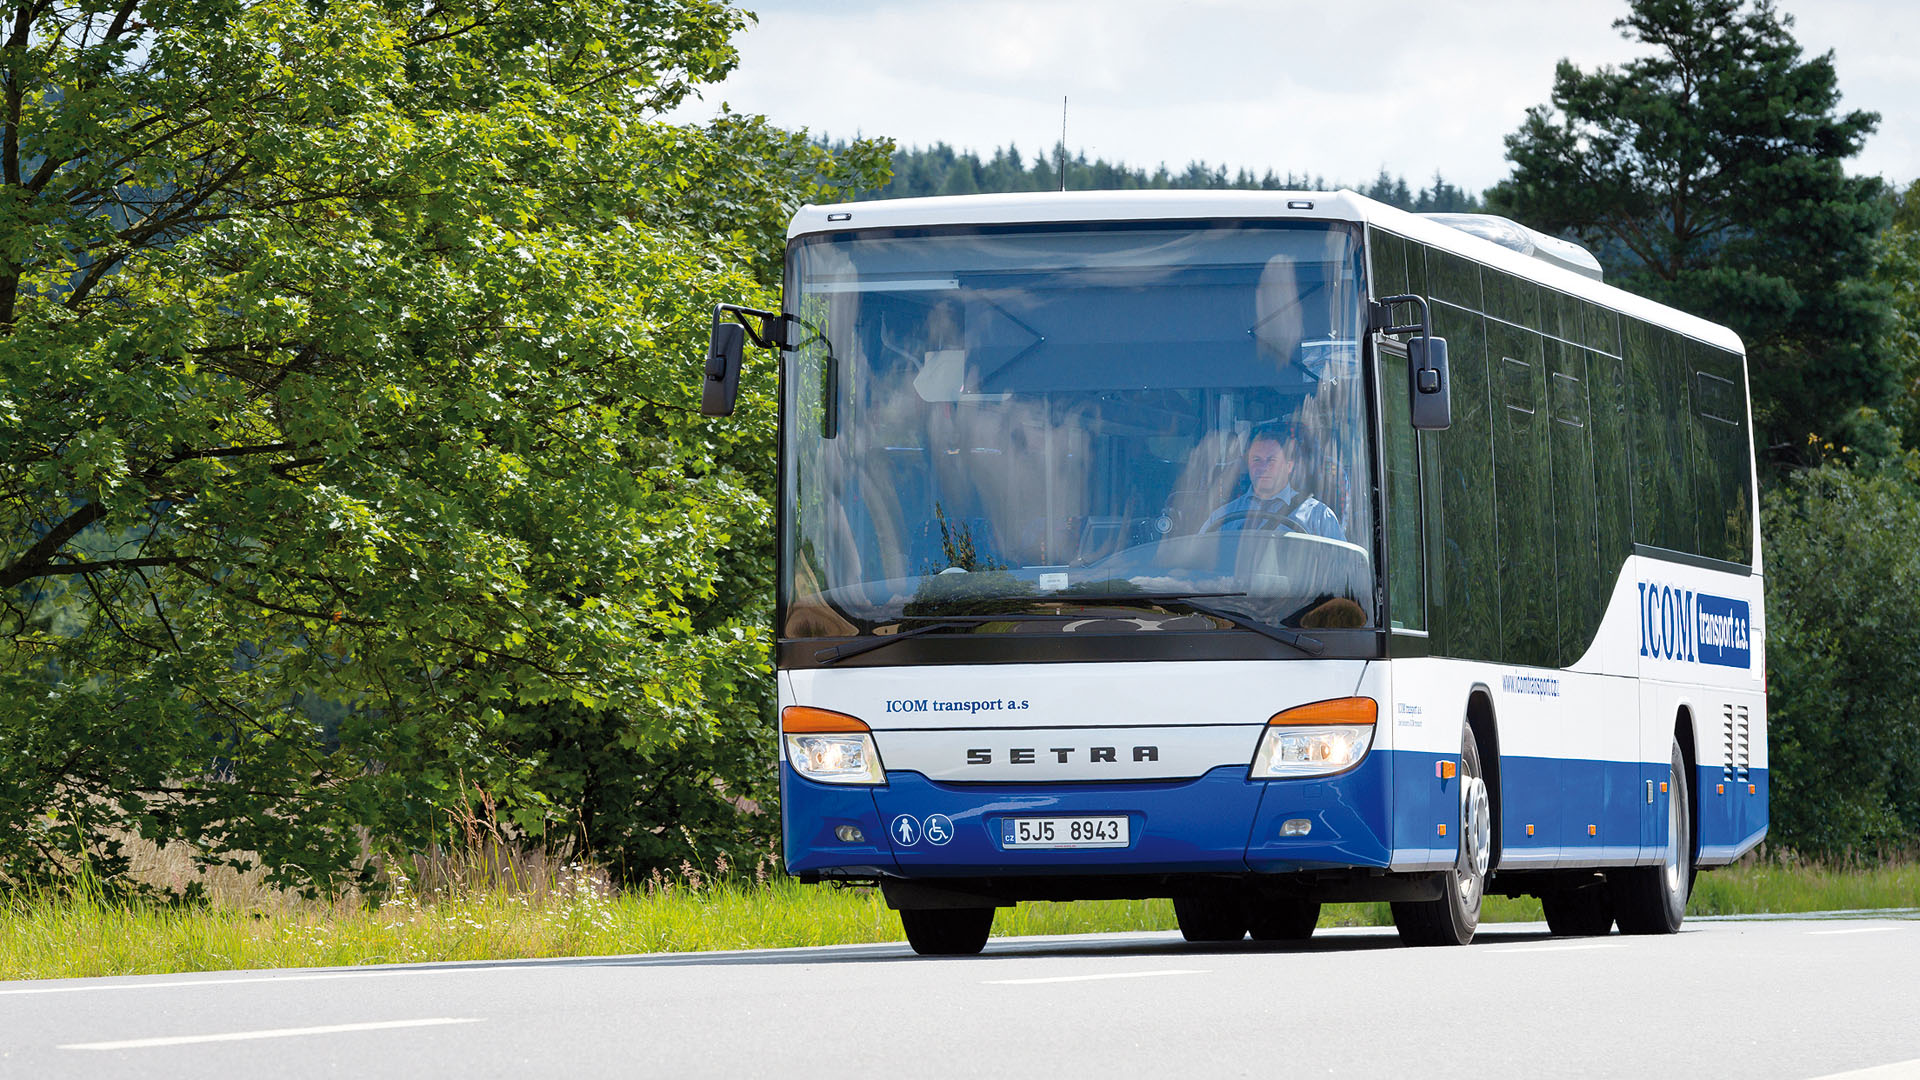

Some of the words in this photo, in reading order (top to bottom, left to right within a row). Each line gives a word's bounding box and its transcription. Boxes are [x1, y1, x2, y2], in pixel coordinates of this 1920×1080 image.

[1638, 582, 1695, 662] ICOM
[1699, 602, 1734, 658] transport
[1734, 617, 1749, 650] a.s.
[886, 700, 928, 713] ICOM
[932, 699, 1003, 714] transport
[1007, 700, 1030, 710] a.s
[967, 746, 1159, 764] SETRA
[1019, 822, 1055, 842] 5J5
[1070, 821, 1119, 841] 8943
